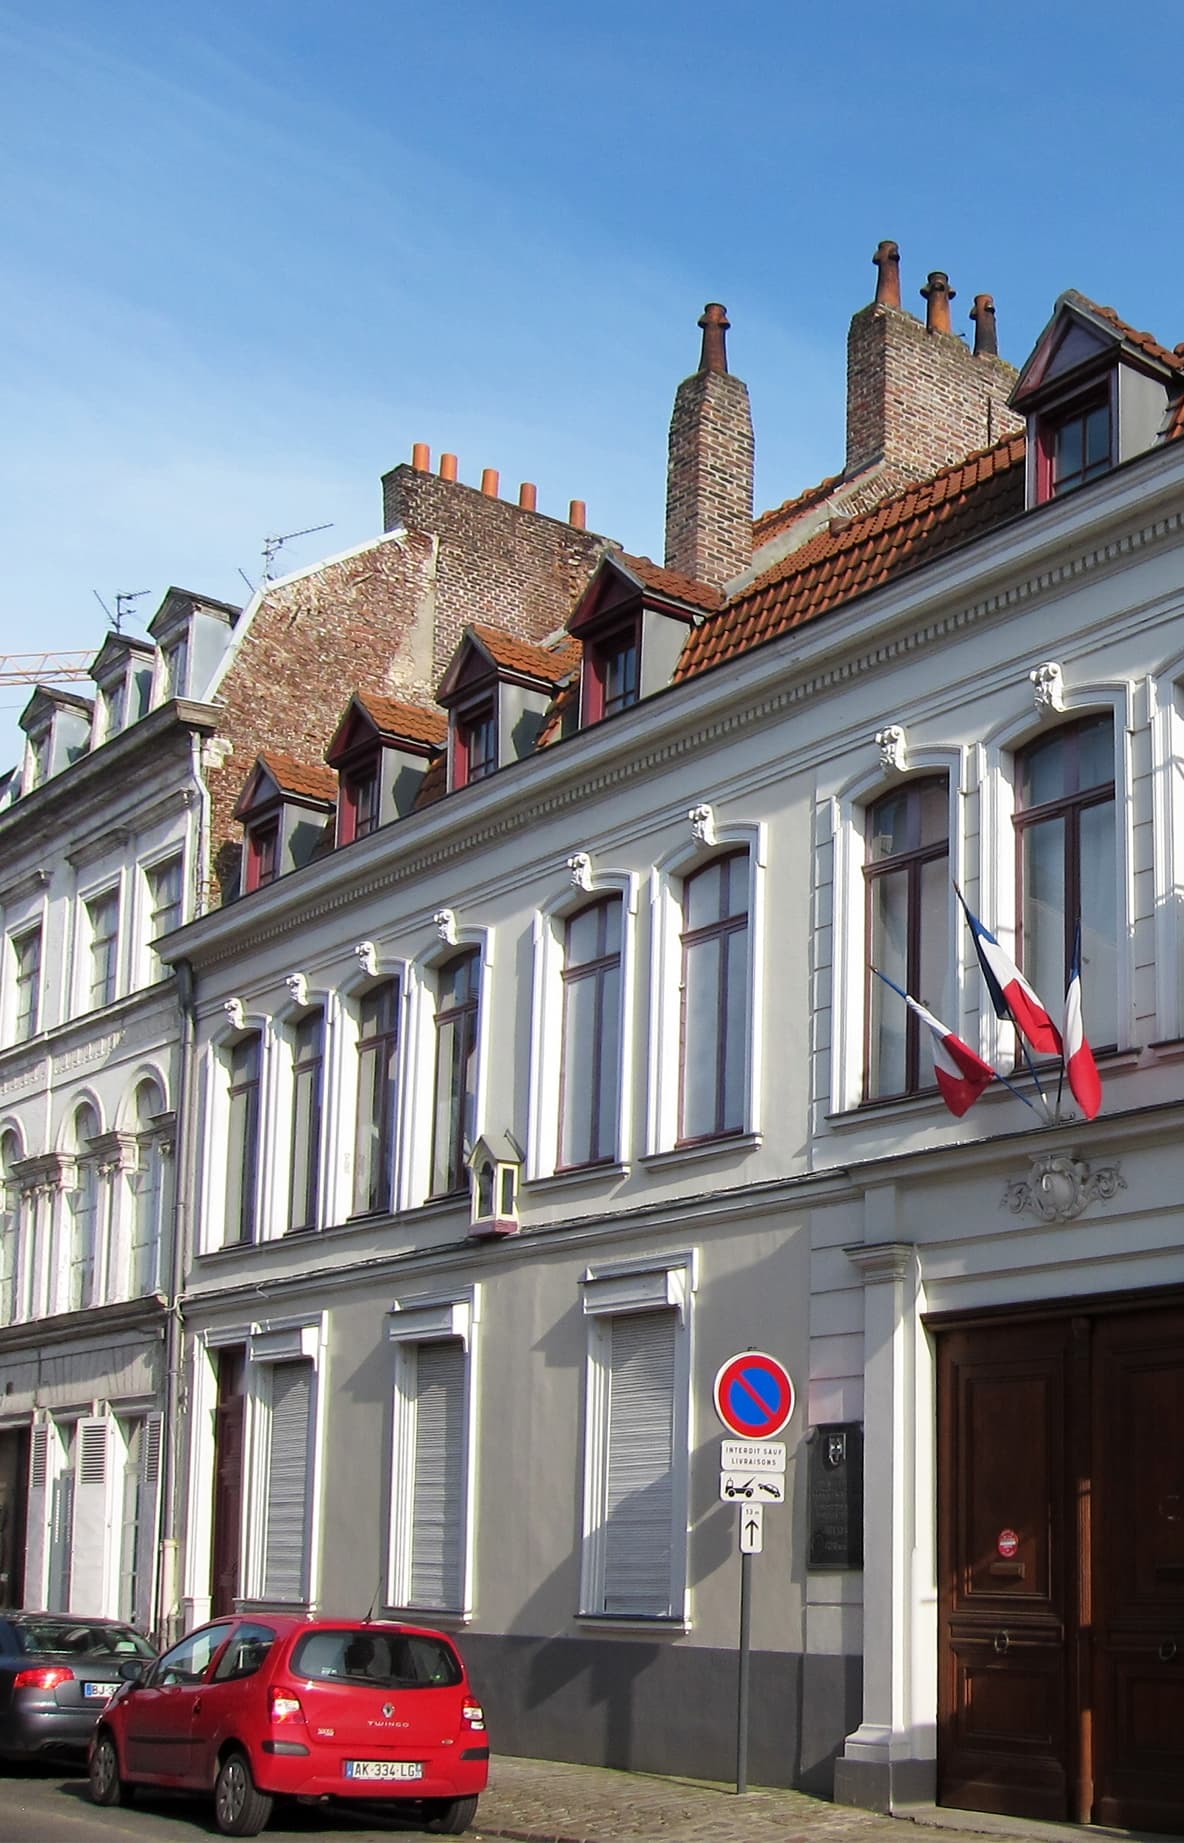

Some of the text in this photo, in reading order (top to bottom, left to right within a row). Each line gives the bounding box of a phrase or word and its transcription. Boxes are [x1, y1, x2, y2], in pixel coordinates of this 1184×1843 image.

[725, 1446, 782, 1456] INTERDIT SAUF
[731, 1457, 777, 1466] LIVRAISONS
[367, 1720, 410, 1728] TWINGO
